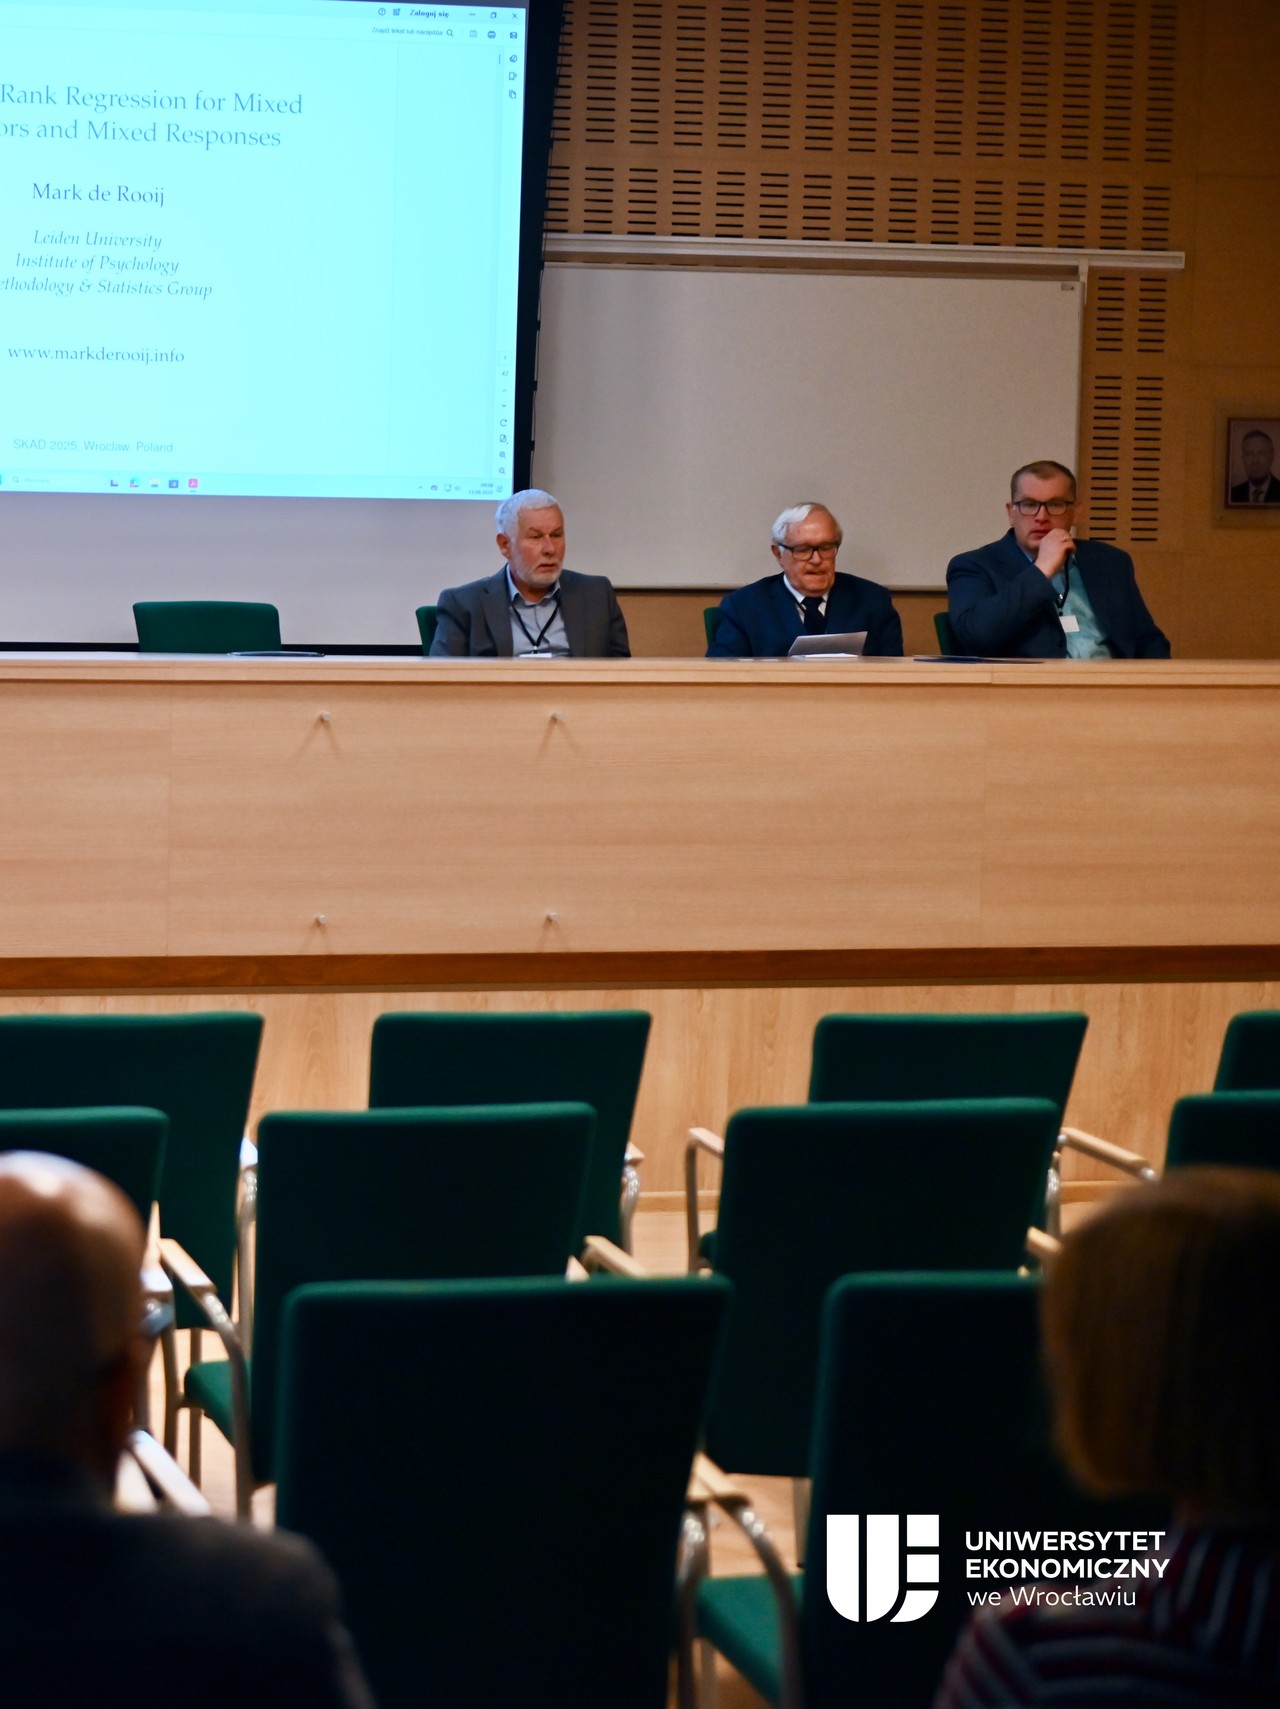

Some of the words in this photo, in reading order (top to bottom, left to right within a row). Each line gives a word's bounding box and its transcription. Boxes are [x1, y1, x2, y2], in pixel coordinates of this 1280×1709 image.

[410, 9, 436, 18] Zaloguj
[1, 83, 58, 105] Rank
[66, 85, 187, 113] Regression
[195, 89, 227, 110] for
[233, 92, 303, 115] Mixed
[36, 119, 78, 139] and
[88, 120, 157, 143] Mixed
[167, 123, 281, 150] Responses
[32, 182, 83, 201] Mark
[88, 184, 111, 202] de
[118, 185, 165, 208] Rooij
[33, 230, 80, 245] Leiden
[85, 231, 163, 252] University
[15, 253, 78, 269] Institute
[81, 254, 98, 274] of
[100, 255, 180, 277] Psychology
[79, 278, 93, 293] &
[97, 279, 163, 295] Statistics
[167, 281, 213, 301] Group
[7, 346, 185, 366] www.markderooij.info
[13, 438, 47, 451] SKAD
[49, 440, 81, 452] 2025,
[136, 441, 174, 453] Poland
